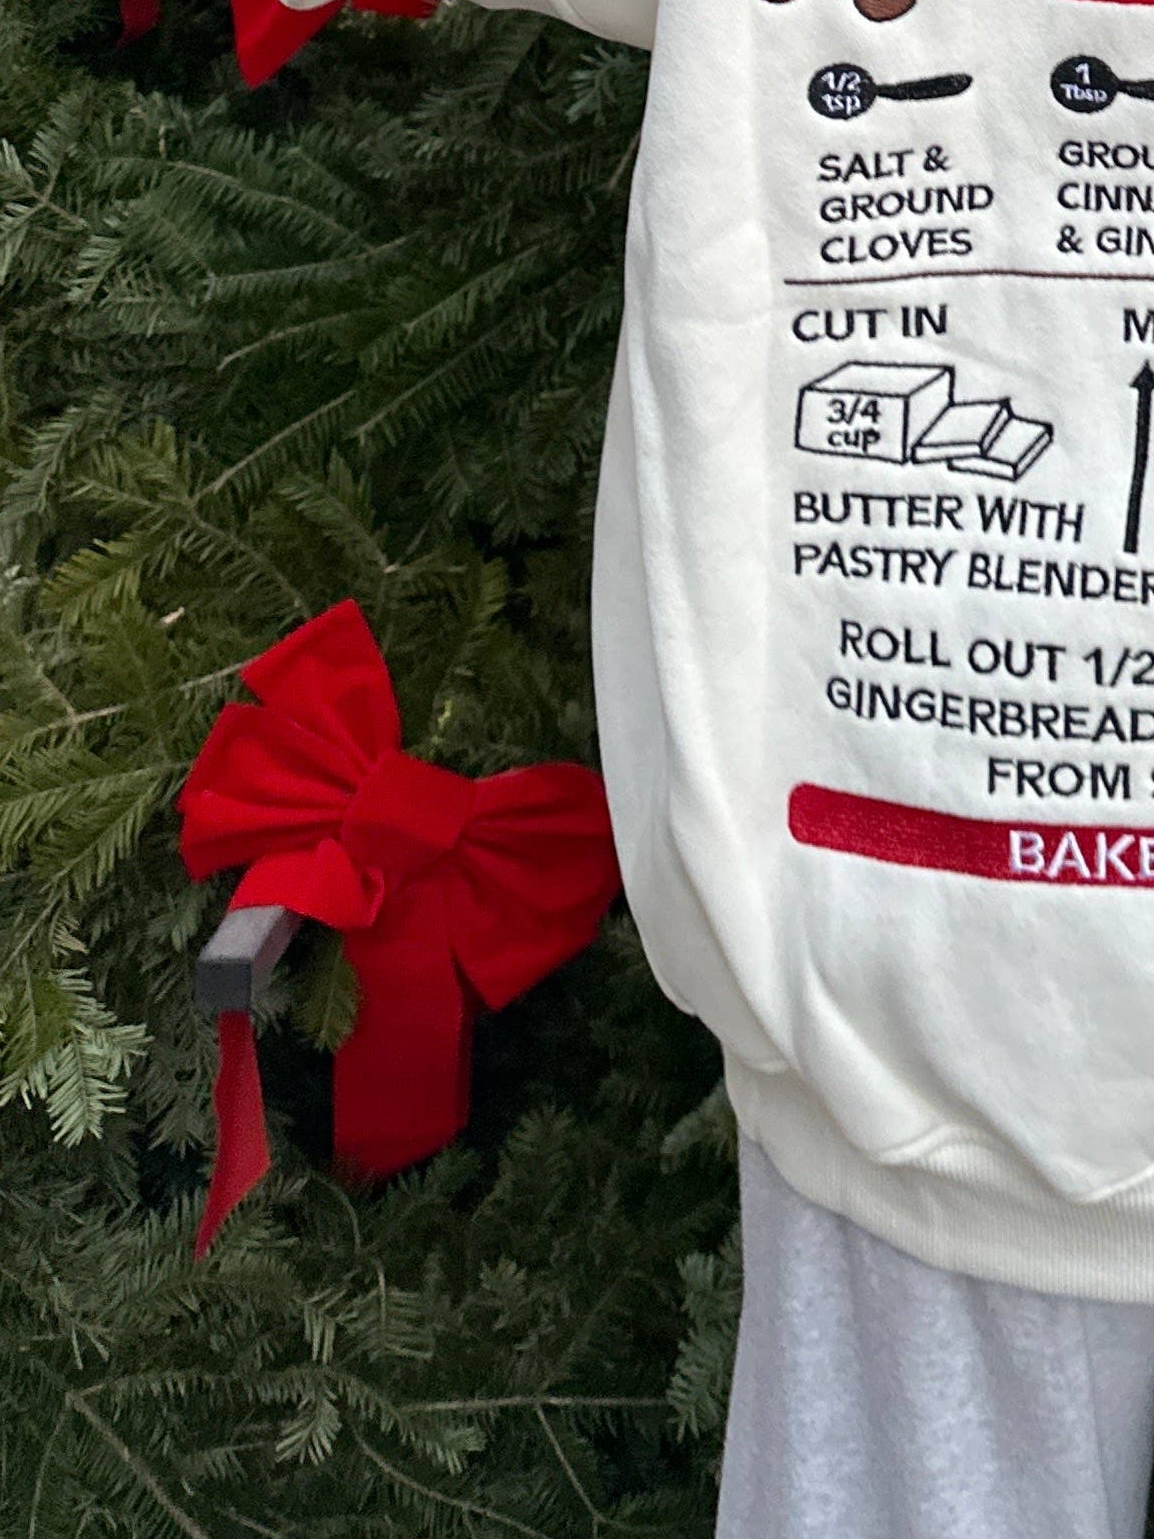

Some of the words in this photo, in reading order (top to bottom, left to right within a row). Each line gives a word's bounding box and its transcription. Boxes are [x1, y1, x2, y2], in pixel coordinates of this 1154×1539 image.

[821, 71, 861, 92] 1/2
[1076, 62, 1090, 85] 1
[821, 93, 862, 116] tsp
[1059, 82, 1107, 104] Tbsp
[818, 148, 913, 183] SALT
[923, 145, 950, 172] &
[819, 183, 994, 224] GROUND
[820, 227, 973, 265] CLOVES
[1056, 224, 1084, 255] &
[792, 307, 887, 342] CUT
[901, 304, 948, 337] IN
[828, 396, 881, 425] 3/4
[828, 428, 881, 453] cup
[794, 491, 964, 531] BUTTER
[978, 496, 1085, 543] WITH
[793, 543, 958, 587] PASTRY
[840, 620, 951, 668] ROLL
[968, 638, 1066, 682] OUT
[988, 758, 1131, 800] FROM
